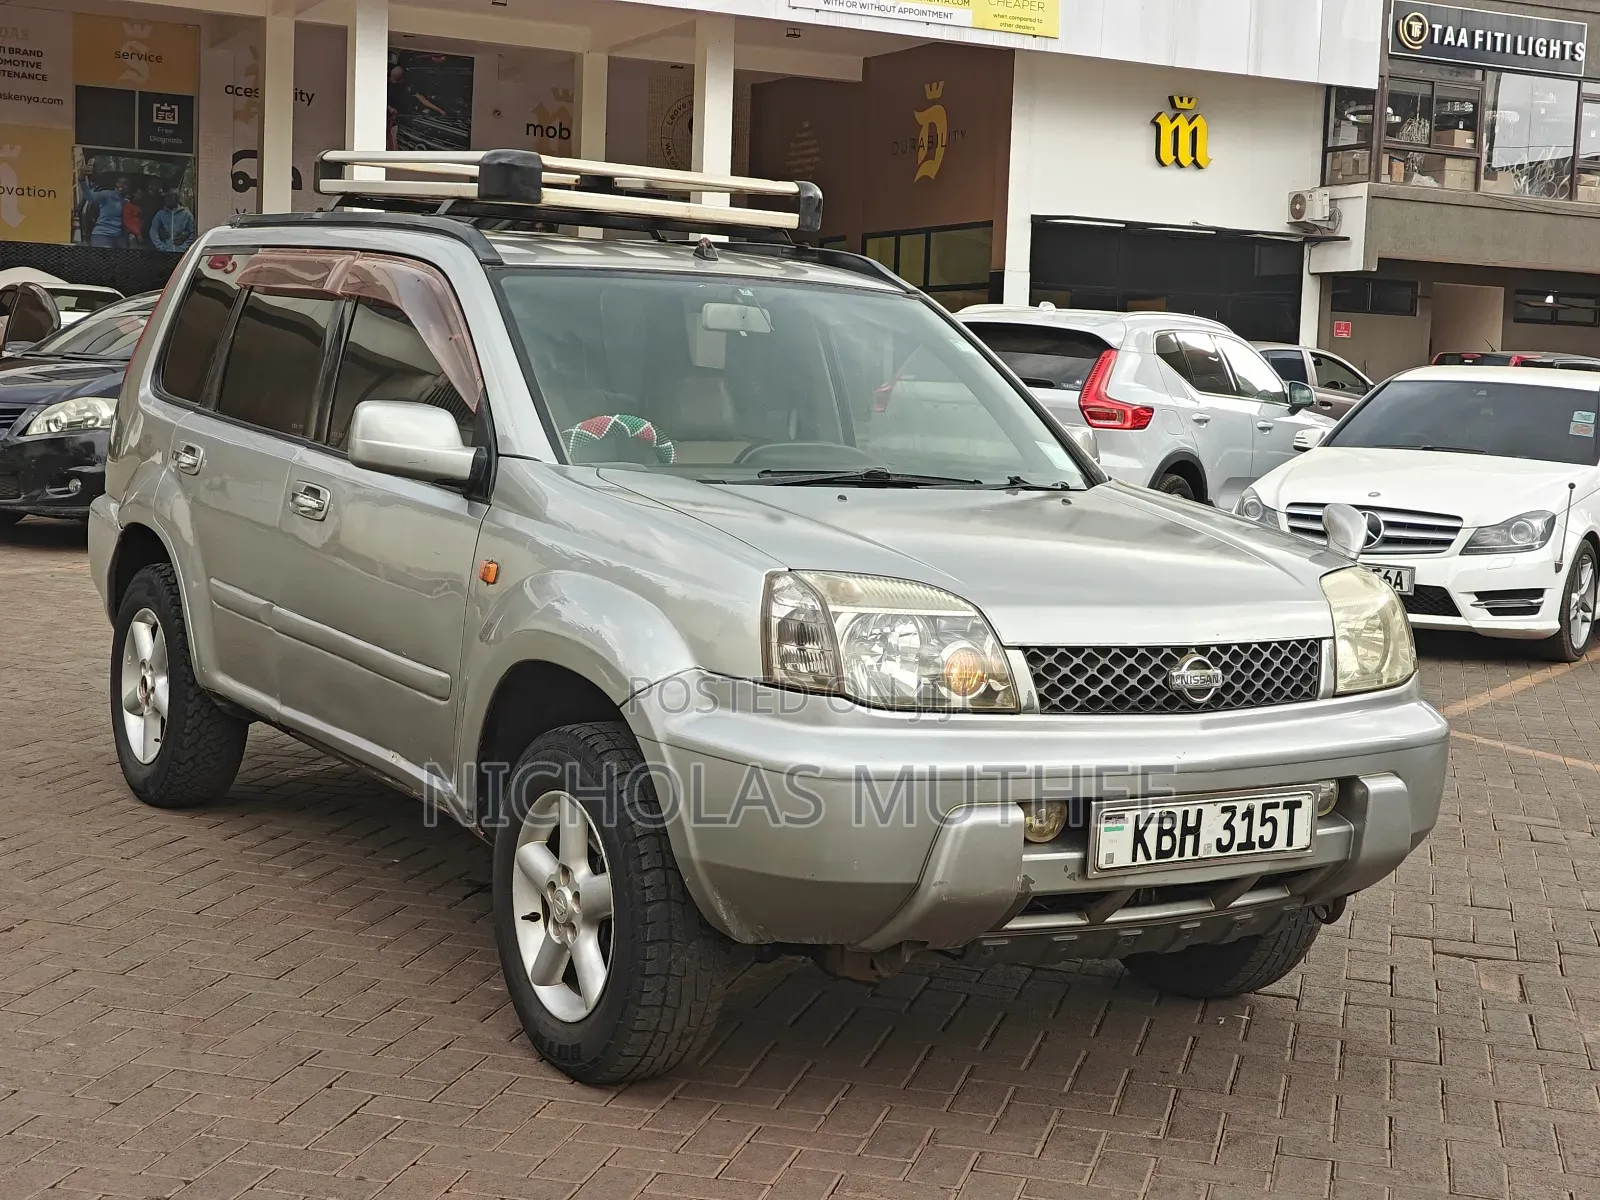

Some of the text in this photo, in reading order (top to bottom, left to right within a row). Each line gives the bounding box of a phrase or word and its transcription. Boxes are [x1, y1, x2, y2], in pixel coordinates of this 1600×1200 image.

[846, 1, 858, 9] OR
[859, 2, 896, 13] WITHOUT
[897, 6, 953, 19] APPOINTMENT
[988, 0, 1045, 12] CHEAPER
[1009, 15, 1036, 23] compared
[1431, 23, 1585, 62] TAA FITI LIGHTS
[9, 47, 43, 58] BRAND
[115, 50, 163, 63] service
[0, 69, 48, 82] TENANCE
[525, 121, 571, 140] mob
[149, 135, 182, 145] Diagnosis
[892, 127, 967, 157] DURABILITY
[1181, 674, 1219, 685] NISSAN
[1131, 808, 1204, 863] KBH
[1215, 798, 1303, 854] 315T
